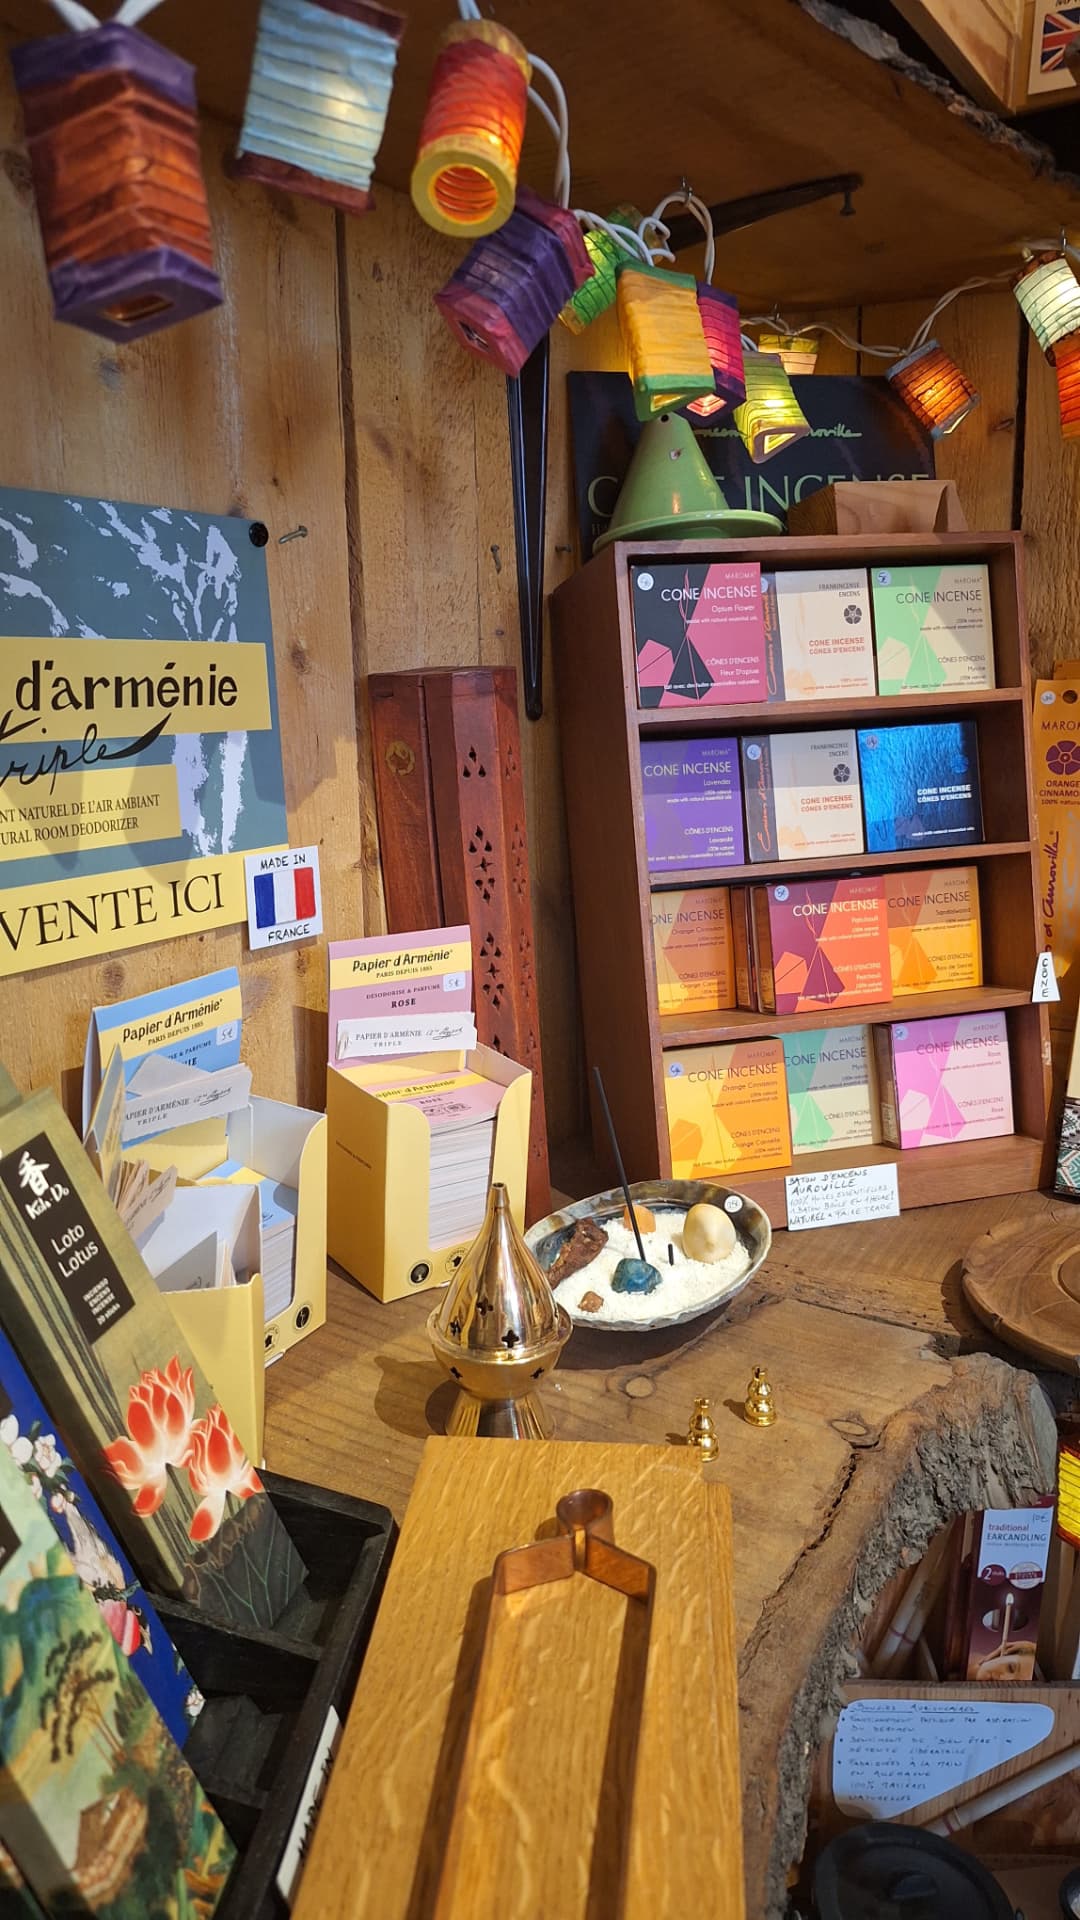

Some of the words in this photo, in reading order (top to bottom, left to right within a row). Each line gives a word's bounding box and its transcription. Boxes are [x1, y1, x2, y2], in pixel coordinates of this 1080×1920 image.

[661, 588, 700, 601] CONE
[703, 585, 758, 600] INCENSE
[818, 583, 860, 591] FRANKINCENSE
[839, 590, 861, 598] ENCENS
[896, 591, 931, 604] CONE
[934, 589, 982, 603] INCENSE
[712, 605, 733, 613] Opium
[734, 604, 755, 612] Flower
[809, 639, 830, 647] CONE
[832, 637, 865, 646] INCENSE
[16, 659, 238, 712] d'arménie
[644, 763, 679, 777] CONE
[682, 761, 732, 775] INCENSE
[917, 788, 938, 796] CONE
[939, 784, 972, 793] INCENSE
[18, 804, 69, 820] NATUREL
[72, 802, 86, 815] DE
[88, 799, 113, 813] L'AIR
[115, 794, 160, 811] AMBIANT
[801, 797, 820, 805] CONE
[822, 794, 853, 803] INCENSE
[34, 825, 70, 841] ROOM
[72, 816, 139, 837] DEODORIZER
[261, 855, 288, 870] MADE
[293, 853, 306, 864] IN
[792, 902, 828, 917] CONE
[830, 898, 879, 913] INCENSE
[887, 895, 921, 909] CONE
[924, 890, 971, 905] INCENSE
[0, 885, 158, 951] VENTE
[168, 872, 225, 918] ICI
[652, 913, 672, 925] ONE
[676, 908, 725, 923] INCENSE
[268, 923, 310, 942] FRANCE
[353, 959, 391, 973] Papier
[396, 968, 418, 976] DEPUIS
[413, 983, 440, 993] PARFUME
[391, 998, 416, 1009] ROSE
[122, 1020, 163, 1043] Papier
[147, 1034, 166, 1046] PARIS
[167, 1026, 190, 1038] DEPUIS
[355, 1031, 381, 1041] PAPIER
[184, 1040, 212, 1055] PARFUME
[916, 1041, 950, 1055] CONE
[952, 1034, 1000, 1051] INCENSE
[819, 1046, 867, 1063] INCENSE
[688, 1068, 724, 1083] CONE
[727, 1062, 777, 1078] INCENSE
[722, 1084, 746, 1092] Orange
[137, 1113, 168, 1126] TRIPLE
[789, 1175, 816, 1185] BATON
[821, 1169, 868, 1181] D'ENCENS
[790, 1213, 825, 1225] NATUREL
[51, 1225, 85, 1255] Loto
[58, 1241, 99, 1277] Lotus
[91, 1292, 115, 1316] INCENSE
[988, 1523, 1029, 1532] traditional
[987, 1533, 1047, 1542] EARCANDLING
[984, 1567, 992, 1580] 2
